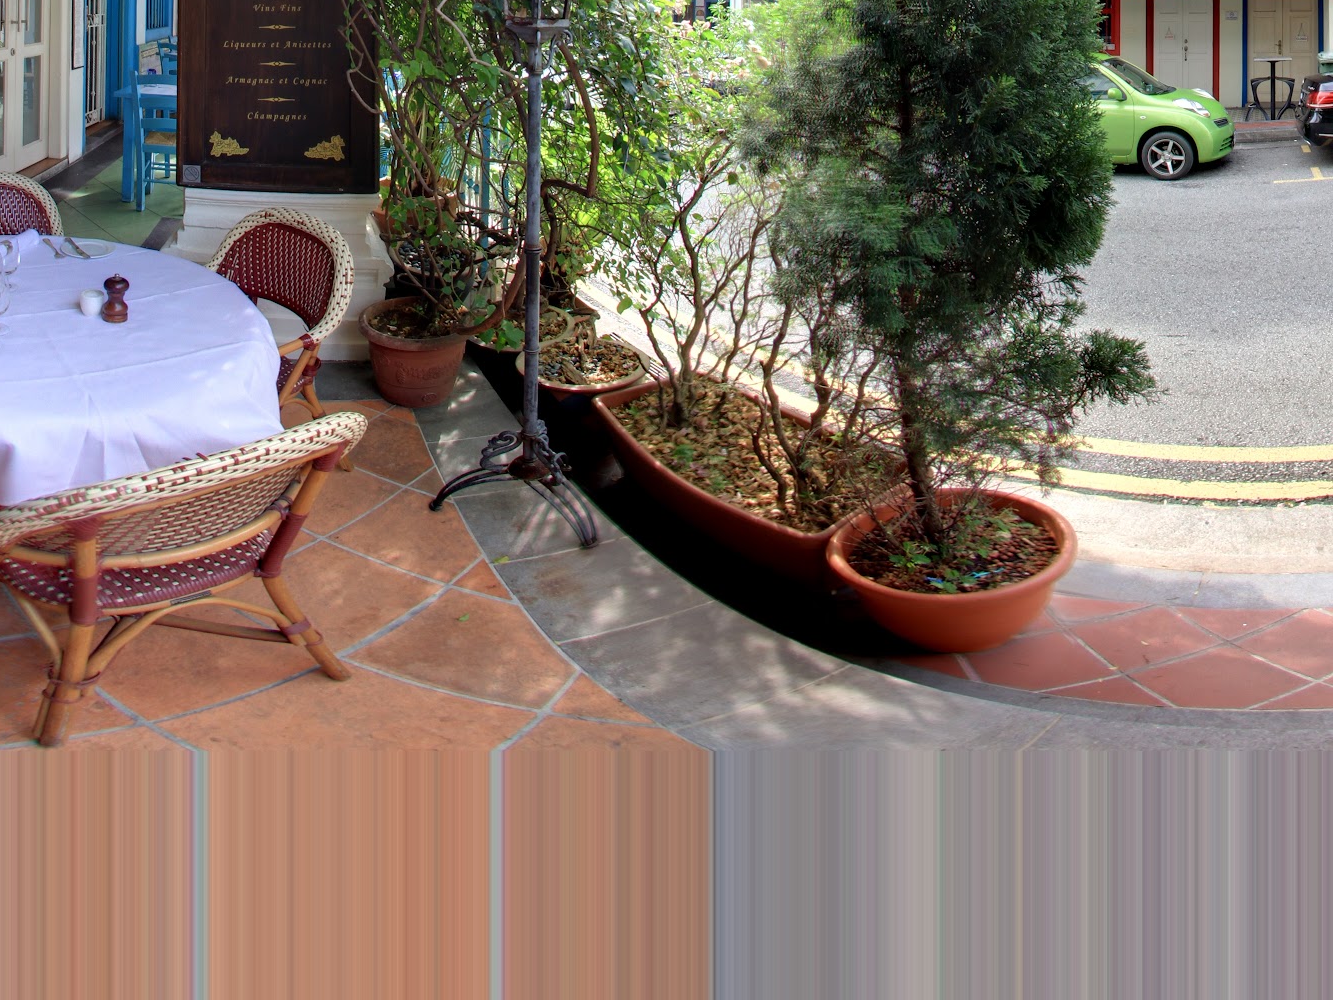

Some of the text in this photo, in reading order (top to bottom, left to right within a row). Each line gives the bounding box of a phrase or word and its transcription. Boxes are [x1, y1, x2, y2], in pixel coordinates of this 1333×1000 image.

[253, 4, 302, 12] Vins Fins
[223, 40, 267, 50] Liqueurs
[284, 41, 332, 49] Anisettes
[226, 76, 274, 86] Armagnac
[293, 77, 328, 87] Cognac
[247, 111, 307, 122] Champagnes
